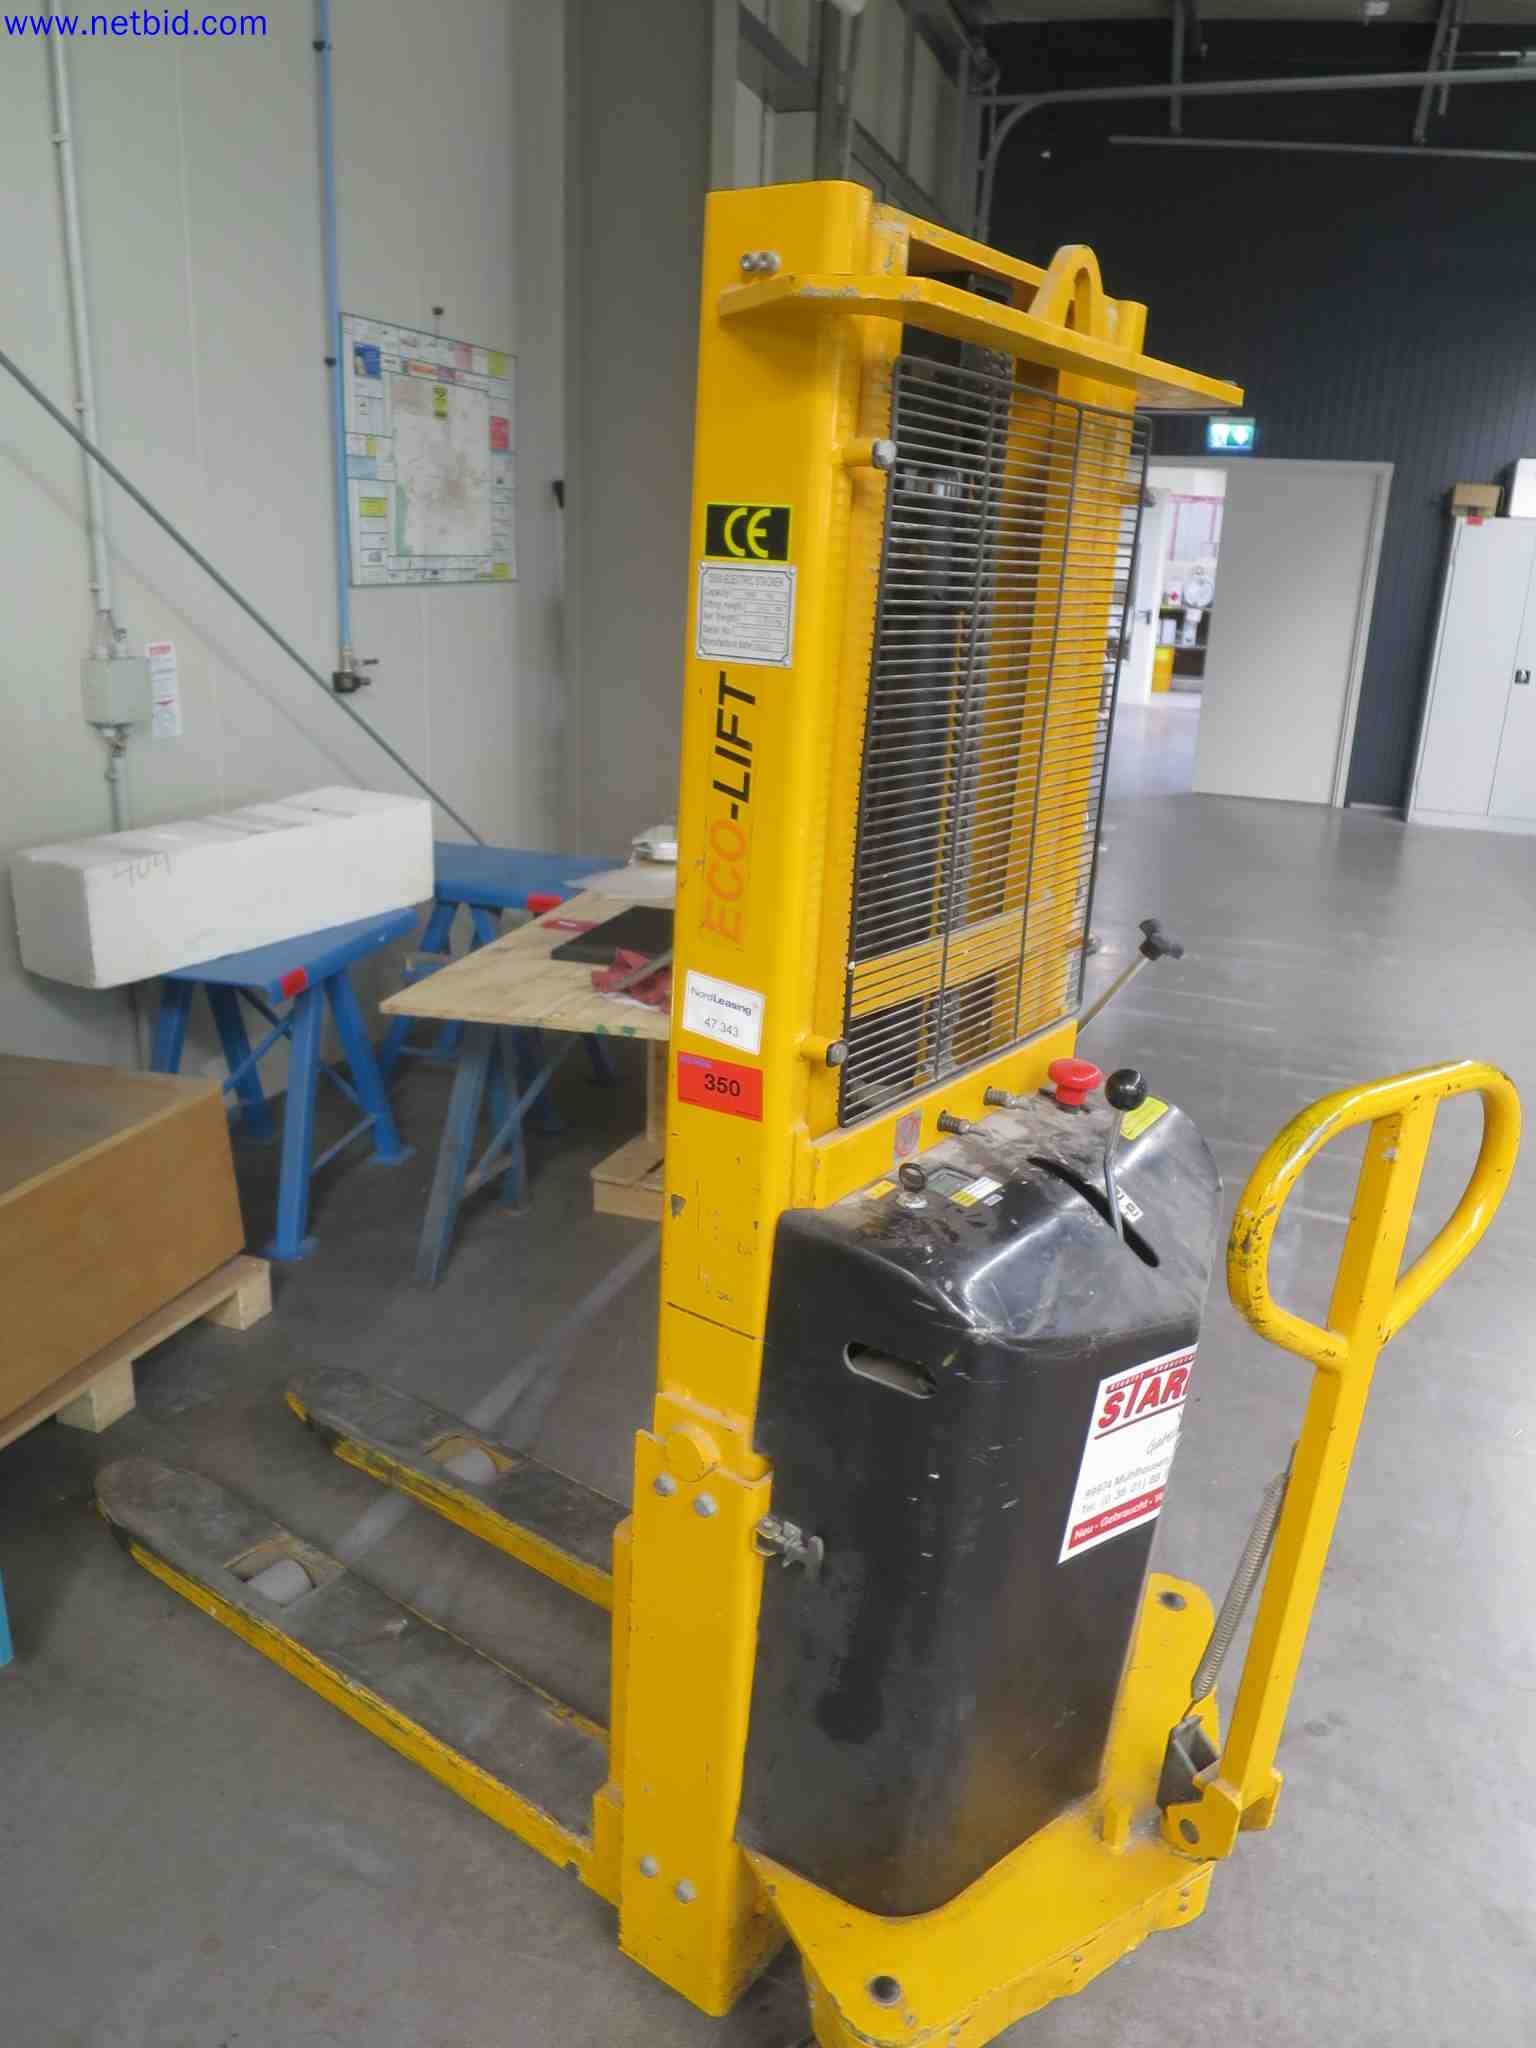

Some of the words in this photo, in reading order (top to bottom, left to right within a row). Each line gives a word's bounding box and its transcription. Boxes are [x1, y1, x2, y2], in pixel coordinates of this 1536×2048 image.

[724, 507, 772, 558] CE
[704, 670, 756, 945] ECO-LIFT
[690, 985, 752, 1016] NordLeasing
[704, 1072, 741, 1097] 350
